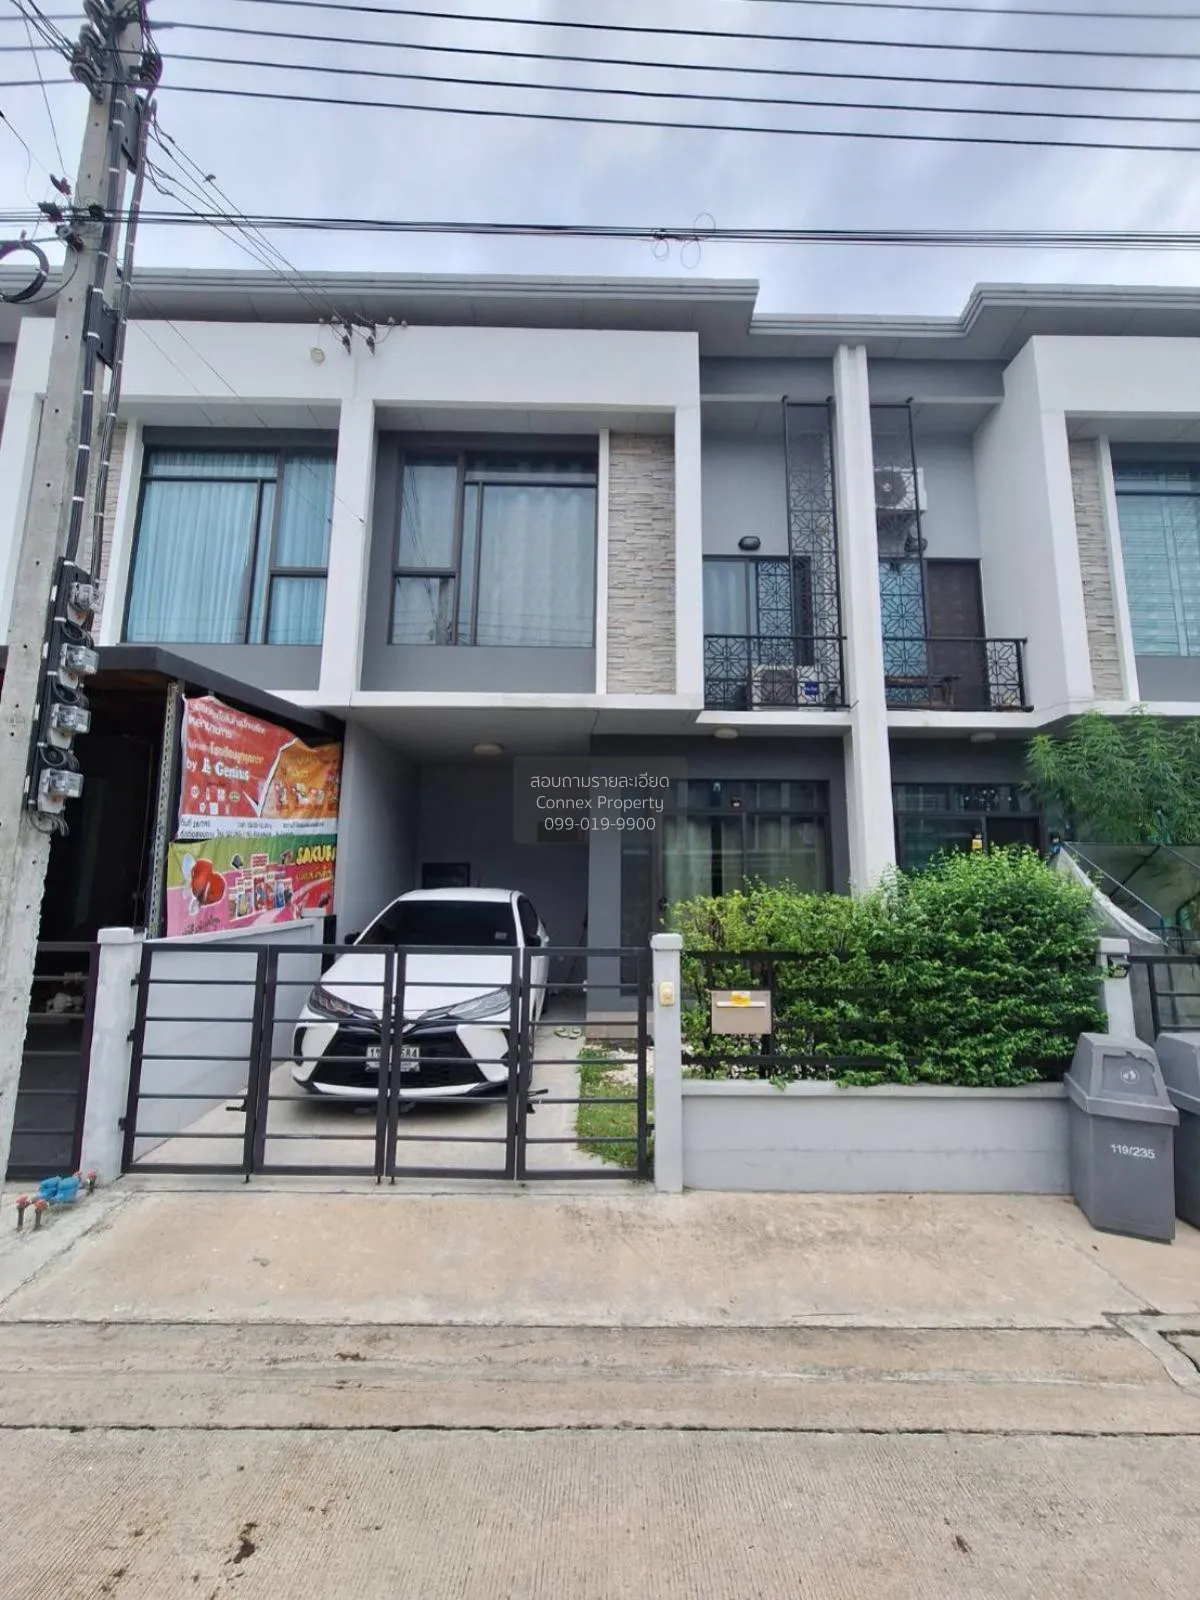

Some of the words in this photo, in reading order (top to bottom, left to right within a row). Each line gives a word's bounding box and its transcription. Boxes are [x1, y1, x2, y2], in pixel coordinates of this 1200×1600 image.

[186, 758, 198, 773] by
[214, 760, 250, 781] Genius
[1110, 1143, 1156, 1160] 119/235
